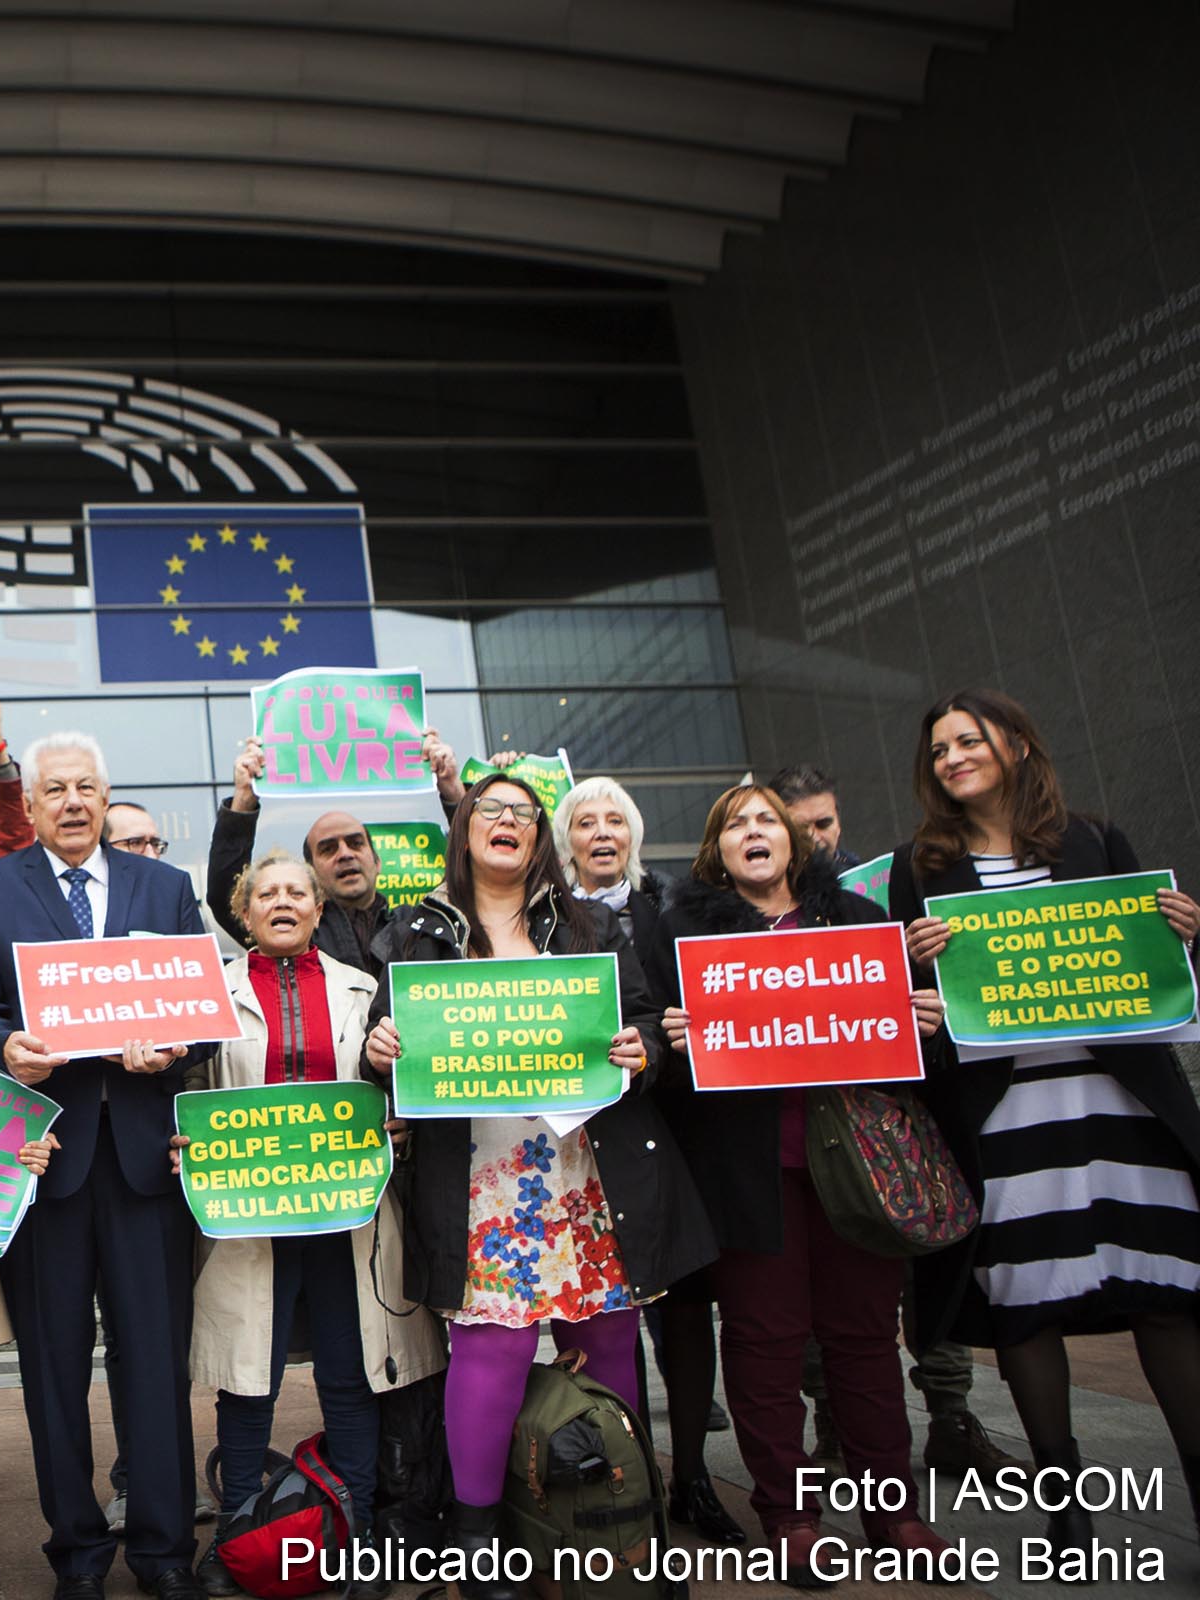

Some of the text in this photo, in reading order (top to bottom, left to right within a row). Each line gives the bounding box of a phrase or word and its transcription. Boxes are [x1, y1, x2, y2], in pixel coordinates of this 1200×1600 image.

[284, 685, 346, 700] POVO
[356, 685, 414, 699] QUER
[262, 702, 421, 744] LULA
[265, 740, 424, 784] LIVRE
[372, 833, 429, 849] TRA O
[400, 853, 447, 869] PELA
[947, 895, 1159, 934] SOLIDARIEDADE
[987, 924, 1125, 954] COM LULA
[37, 956, 204, 987] #FreeLula
[702, 953, 886, 994] #FreeLula
[997, 949, 1122, 977] E O POVO
[408, 977, 600, 1001] SOLIDARIEDADE
[981, 972, 1150, 1003] BRASILEIRO!
[39, 998, 220, 1028] #LulaLivre
[443, 1003, 568, 1024] COM LULA
[987, 998, 1152, 1028] #LULALIVRE
[449, 1028, 563, 1048] E O POVO
[703, 1013, 899, 1052] #LulaLivre
[431, 1052, 585, 1073] BRASILEIRO!
[434, 1077, 584, 1099] #LULALIVRE
[209, 1100, 354, 1130] CONTRA O
[188, 1135, 282, 1162] GOLPE
[309, 1128, 382, 1153] PELA
[191, 1157, 385, 1191] DEMOCRACIA!
[204, 1186, 377, 1220] #LULALIVRE
